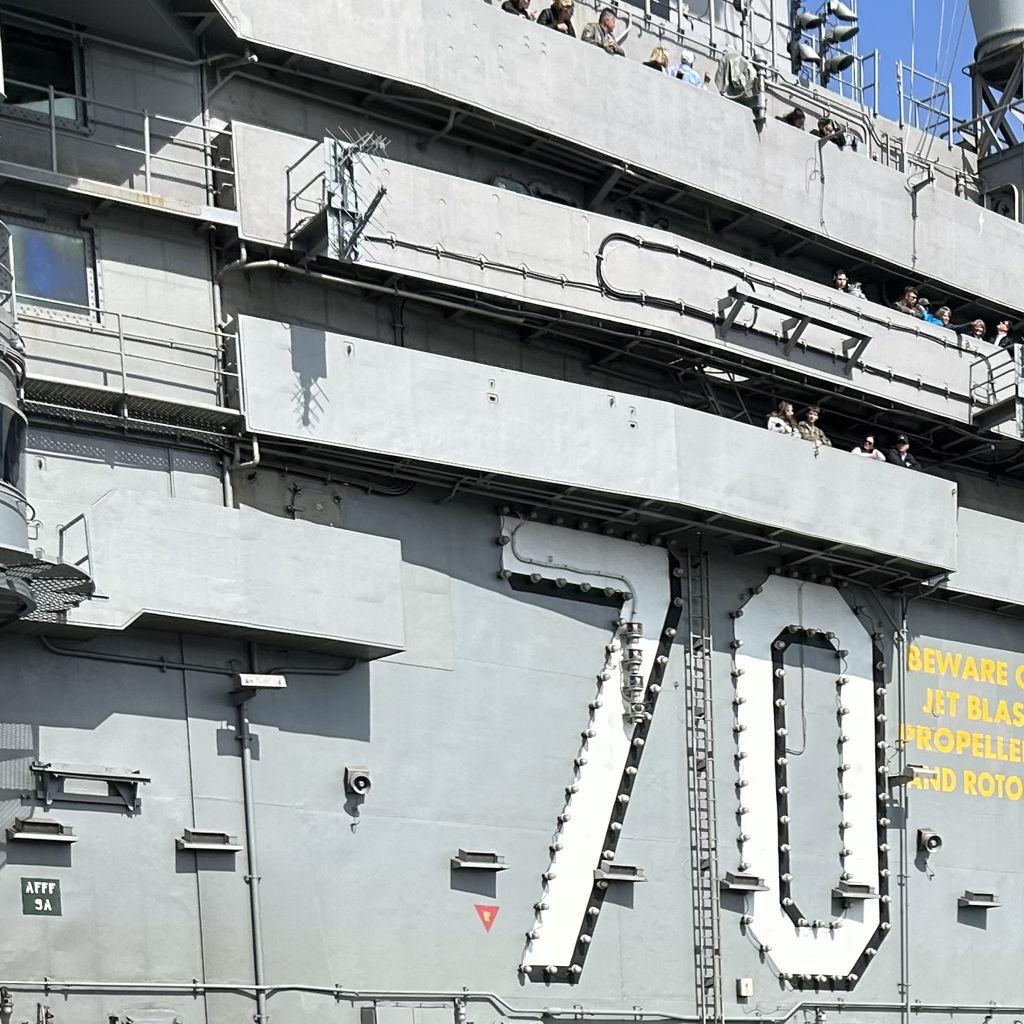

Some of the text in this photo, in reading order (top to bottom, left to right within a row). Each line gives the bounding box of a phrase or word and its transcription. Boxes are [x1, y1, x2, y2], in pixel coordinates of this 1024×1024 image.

[908, 644, 1008, 686] BEWARE
[922, 687, 960, 718] JET
[501, 514, 889, 989] 70
[25, 881, 56, 895] AFFF
